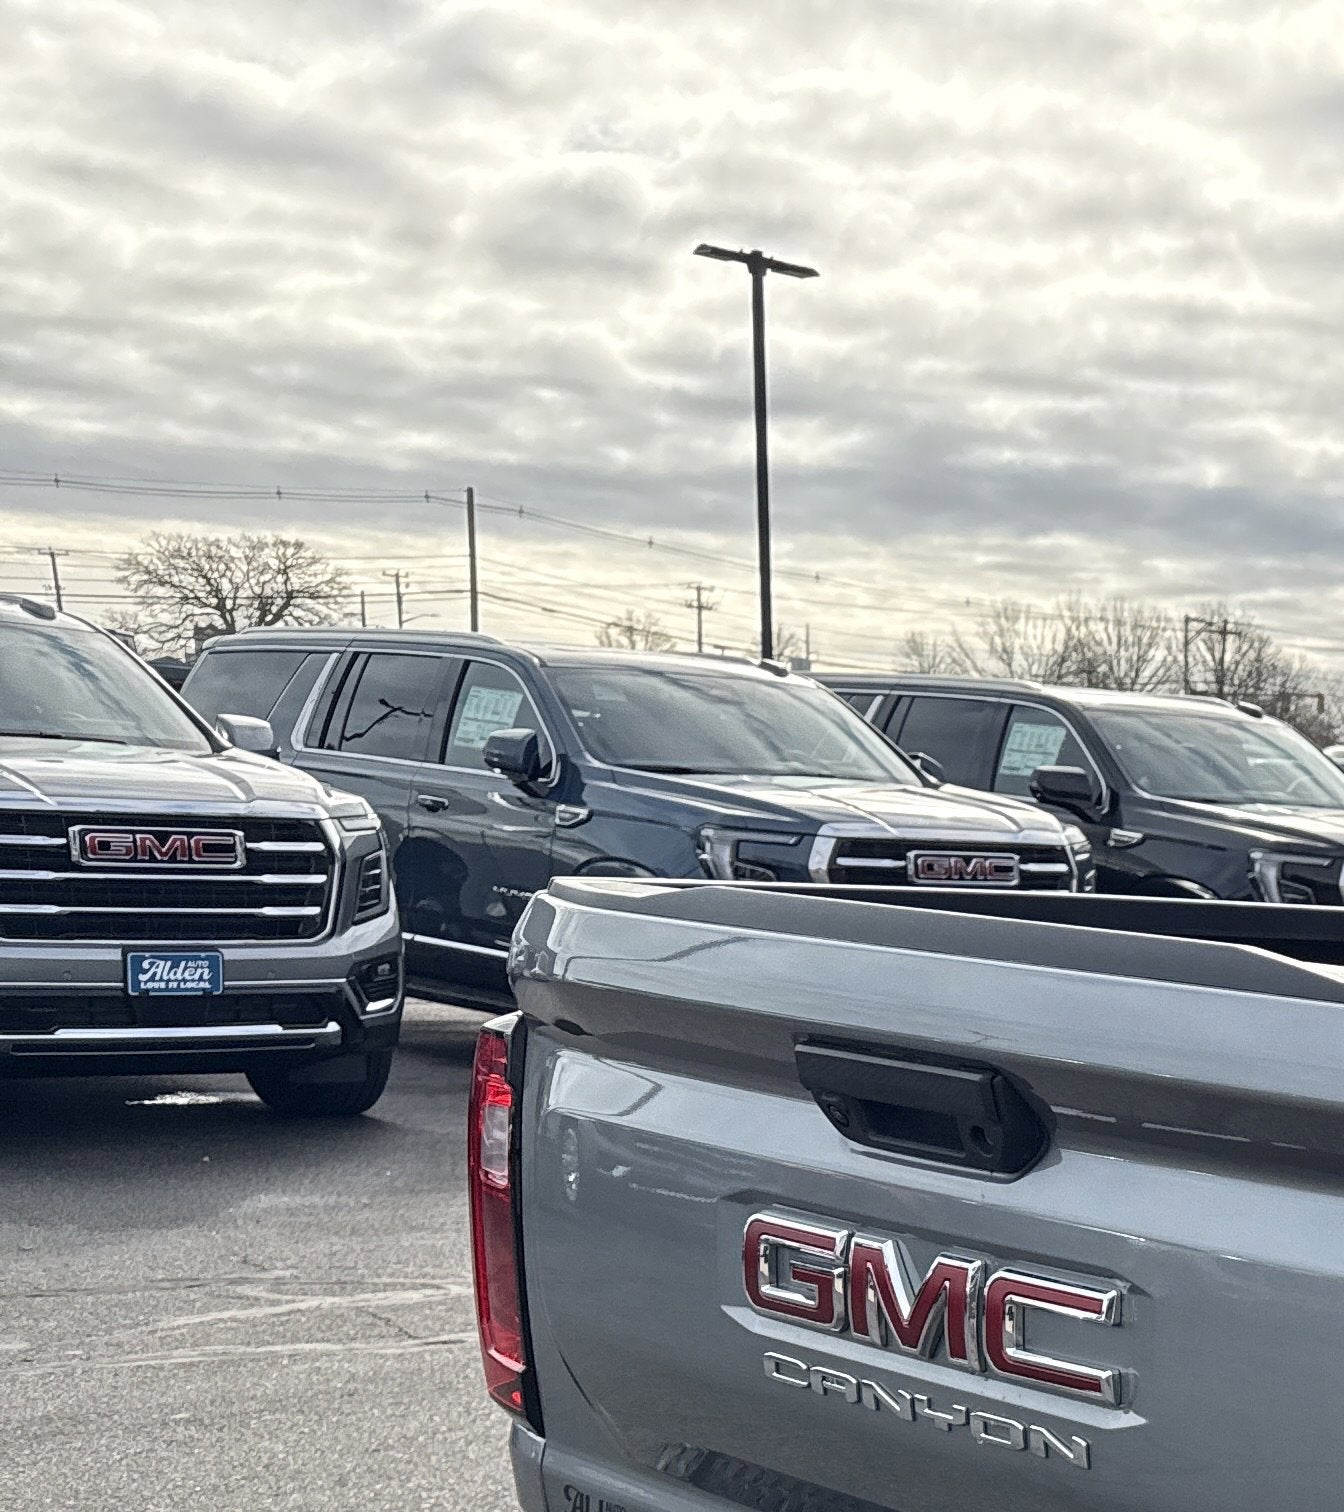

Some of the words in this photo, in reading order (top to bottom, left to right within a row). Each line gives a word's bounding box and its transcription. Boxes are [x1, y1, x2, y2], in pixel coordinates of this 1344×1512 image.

[84, 832, 237, 862] GMC
[917, 856, 1016, 880] GMC
[138, 958, 213, 982] Alden
[741, 1211, 1122, 1408] GMC
[762, 1350, 1092, 1471] CANYON
